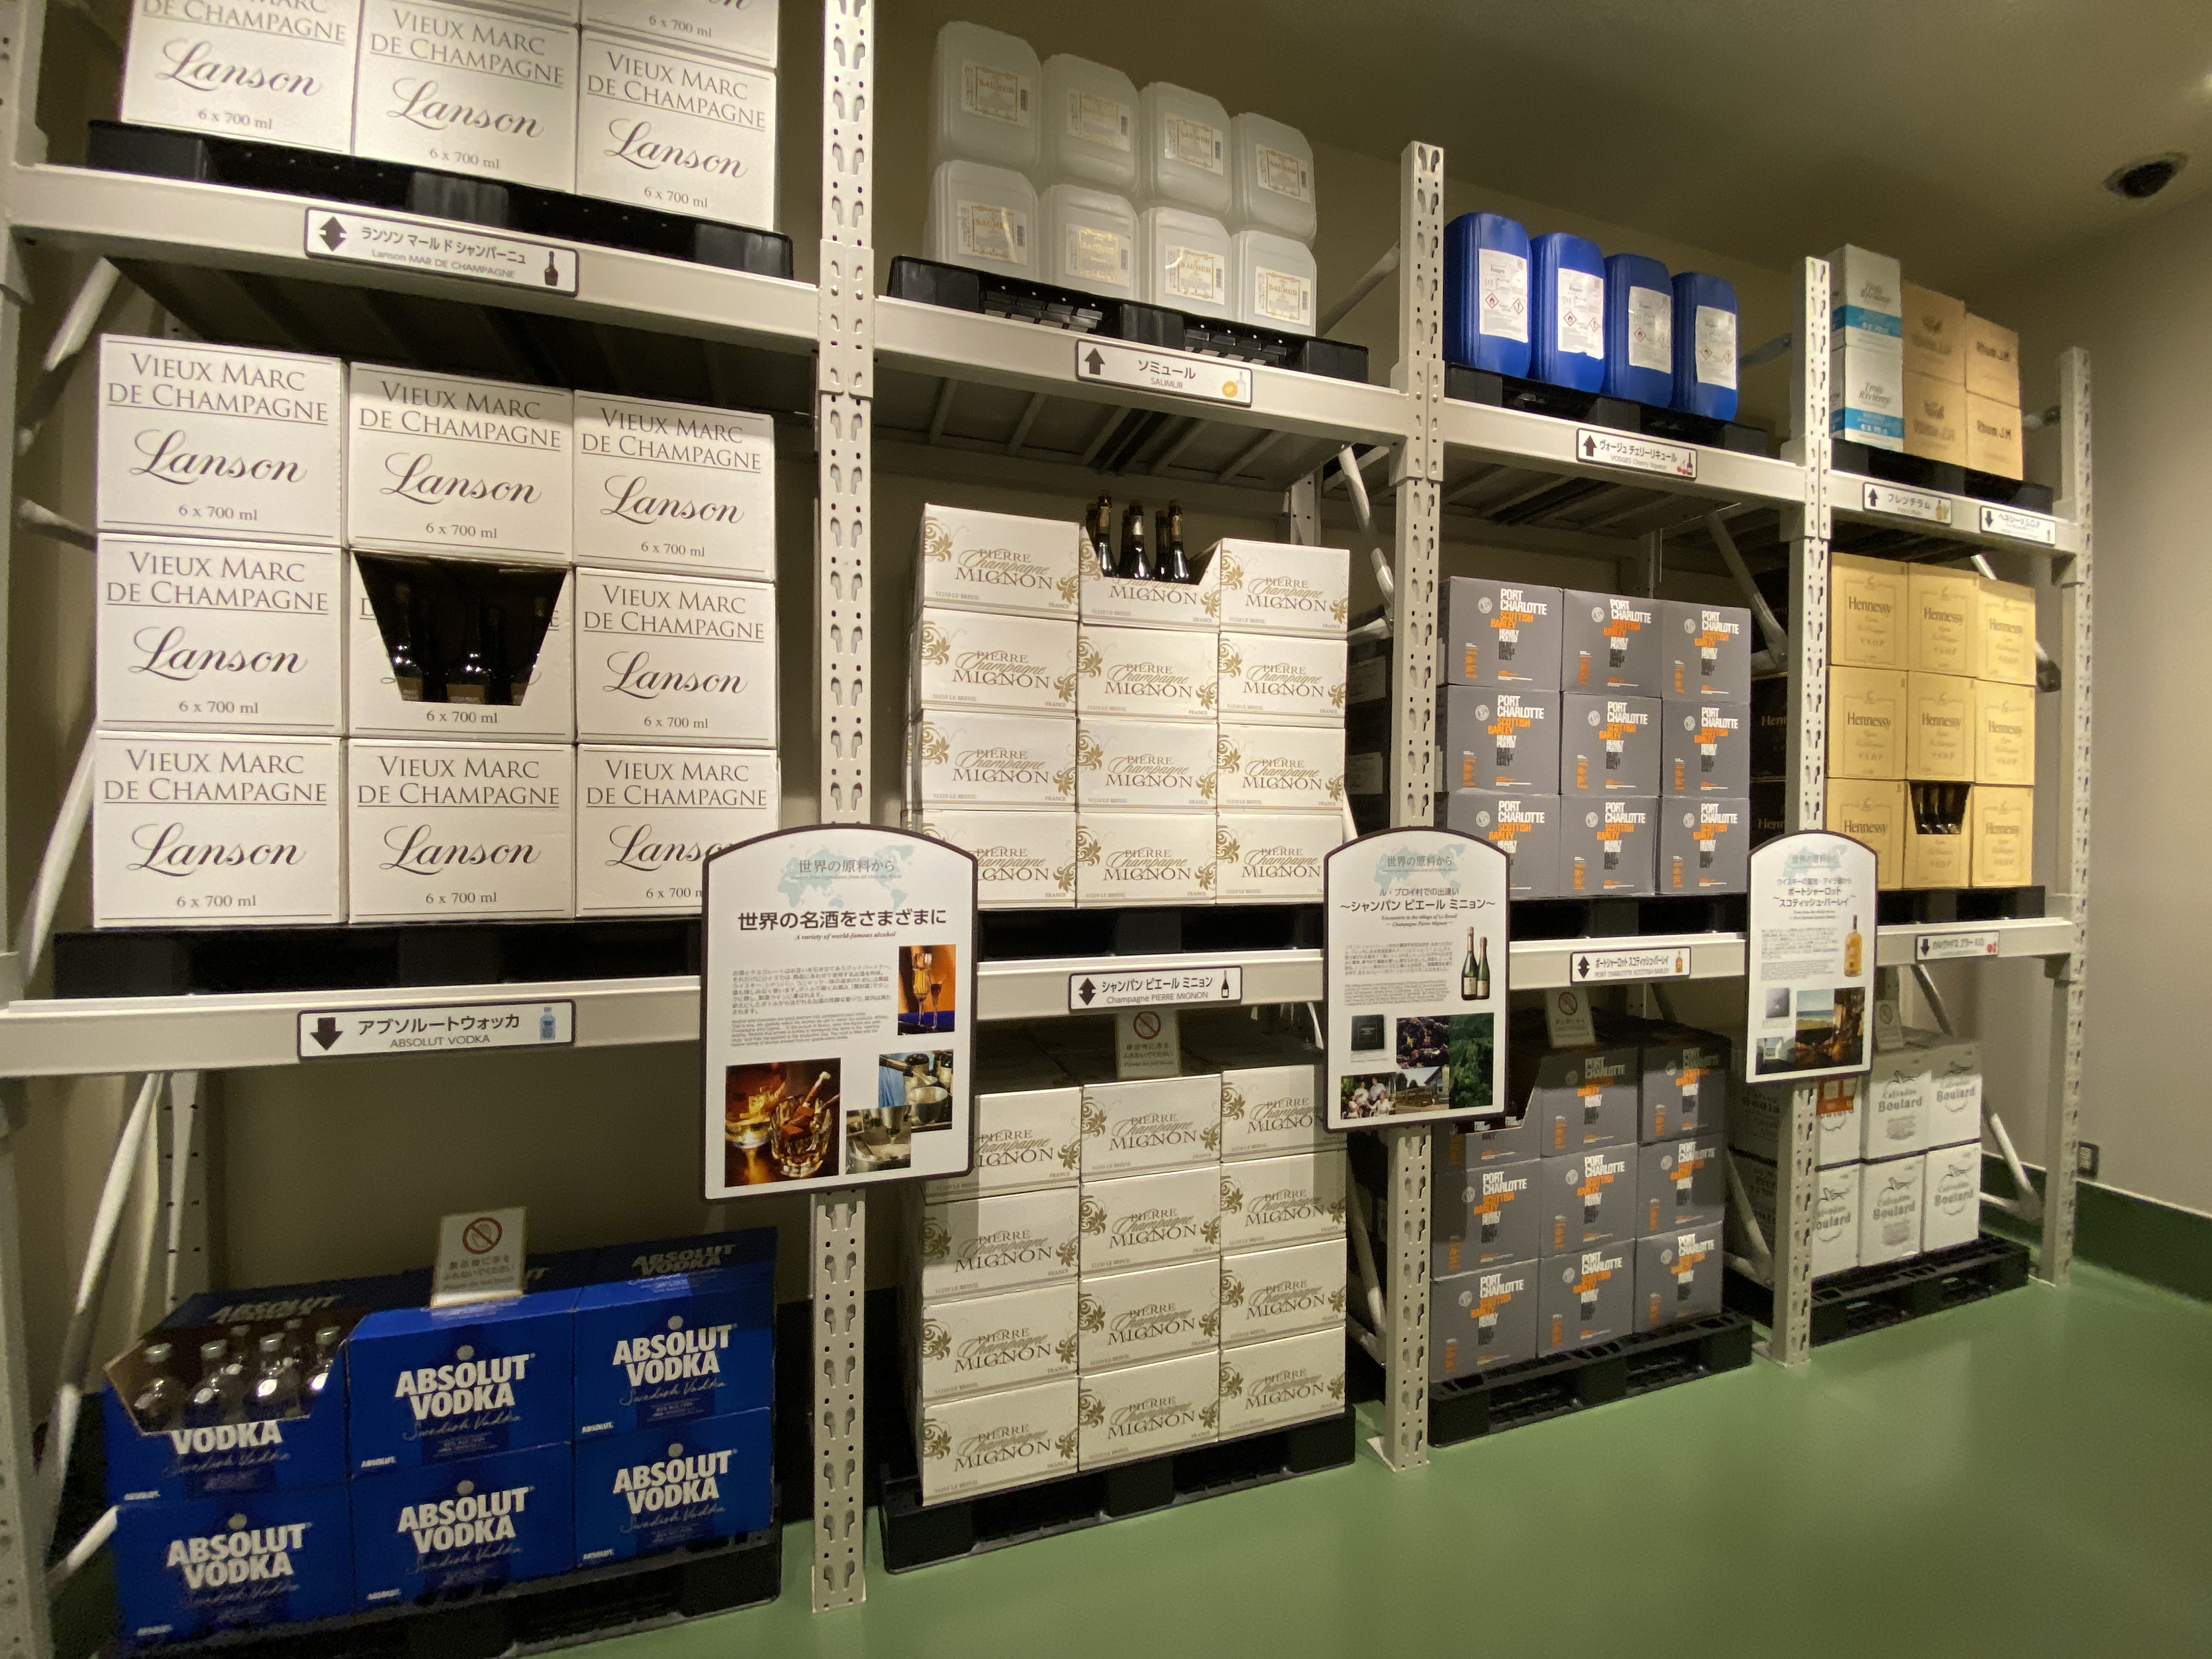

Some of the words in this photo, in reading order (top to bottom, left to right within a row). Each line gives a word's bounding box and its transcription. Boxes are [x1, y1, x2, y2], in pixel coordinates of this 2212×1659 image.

[393, 9, 464, 40] VIEUX
[473, 24, 545, 56] MARC
[370, 33, 401, 54] DE
[410, 38, 564, 84] CHAMPAGNE
[607, 52, 674, 84] VIEUX
[681, 67, 748, 100] MARC
[386, 77, 544, 138] Lanson
[588, 75, 616, 95] DE
[624, 81, 765, 128] CHAMPAGNE
[603, 119, 748, 178] Lanson
[644, 187, 652, 197] 6
[656, 191, 662, 200] x
[667, 191, 689, 204] 700
[693, 198, 708, 208] ml
[362, 227, 403, 244] ランソン
[408, 234, 438, 251] マール
[456, 243, 526, 264] シャンパーニュ
[372, 250, 406, 262] Lanson
[409, 255, 431, 266] MAR
[435, 259, 448, 268] DE
[450, 260, 514, 278] CHAMPAGNE
[1268, 284, 1298, 297] SAUMUR
[132, 353, 213, 382] VIEUX
[221, 362, 305, 391] MARC
[1138, 360, 1195, 379] ソミュール
[1151, 377, 1183, 389] SAUMUR
[109, 382, 142, 404] DE
[153, 384, 328, 421] CHAMPAGNE
[382, 381, 456, 410] VIEUX
[466, 392, 541, 420] MARC
[360, 408, 392, 428] DE
[402, 410, 561, 448] CHAMPAGNE
[600, 408, 668, 435] VIEUX
[677, 418, 742, 443] MARC
[582, 433, 610, 453] DE
[619, 436, 761, 470] CHAMPAGNE
[1600, 439, 1627, 453] ヴォージュ
[129, 430, 307, 485] Lanson
[380, 453, 542, 505] Lanson
[600, 475, 744, 524] Lanson
[179, 505, 188, 516] 6
[193, 509, 202, 517] x
[207, 506, 234, 518] 700
[239, 509, 257, 521] ml
[129, 551, 212, 577] VIEUX
[222, 557, 305, 582] MARC
[958, 549, 1051, 575] Champagne
[980, 549, 1031, 563] PIERRE
[955, 567, 1052, 589] MIGNON
[108, 582, 140, 602] DE
[151, 581, 329, 611] CHAMPAGNE
[1110, 586, 1198, 605] MIGNON
[1245, 595, 1327, 611] MIGNON
[1500, 588, 1523, 601] PORT
[1500, 600, 1547, 615] CHARLOTTE
[1702, 611, 1721, 622] PORT
[1849, 596, 1891, 617] Hennessy
[1702, 620, 1739, 634] CHARLOTTE
[128, 627, 308, 681] Lanson
[1108, 663, 1189, 684] Champagne
[1127, 664, 1173, 674] PIERRE
[1105, 682, 1192, 697] MIGNON
[1497, 695, 1521, 707] PORT
[1497, 706, 1544, 719] CHARLOTTE
[1848, 712, 1892, 730] Hennessy
[377, 755, 455, 777] VIEUX
[465, 758, 539, 778] MARC
[357, 785, 390, 804] DE
[400, 782, 560, 804] CHAMPAGNE
[1605, 802, 1625, 812] PORT
[1605, 811, 1646, 823] CHARLOTTE
[380, 824, 541, 875] Lanson
[799, 860, 894, 873] 世界の原料から
[1387, 856, 1452, 867] 世界の原料から
[426, 893, 434, 904] 6
[452, 893, 475, 903] 700
[481, 892, 496, 902] ml
[1406, 899, 1445, 911] ピエール
[738, 908, 946, 931] 世界の名酒をさまざまに
[832, 932, 872, 940] world-famous
[1103, 978, 1142, 994] シャンパン
[1146, 977, 1180, 990] ピエール
[1183, 977, 1212, 989] ミニョン
[1107, 995, 1149, 1005] Champagne
[1152, 993, 1174, 1001] PIERRE
[1176, 992, 1208, 1000] MIGNON
[358, 1014, 519, 1035] アブソルートウォッカ
[390, 1036, 444, 1048] ABSOLUT
[447, 1035, 490, 1046] VODKA
[1878, 1097, 1922, 1113] Boulard
[1131, 1113, 1176, 1125] PIERRE
[1109, 1130, 1198, 1151] MIGNON
[1245, 1205, 1325, 1227] MIGNON
[1873, 1200, 1915, 1220] Boulard
[613, 1324, 732, 1365] ABSOLUT
[626, 1351, 720, 1386] VODKA
[954, 1344, 1051, 1373] MIGNON
[395, 1354, 530, 1397] ABSOLUT
[410, 1383, 516, 1420] VODKA
[1108, 1411, 1194, 1440] MIGNON
[171, 1420, 283, 1454] VODKA
[613, 1450, 732, 1494] ABSOLUT
[627, 1476, 719, 1514] VODKA
[398, 1487, 529, 1533] ABSOLUT
[167, 1523, 306, 1567] ABSOLUT
[413, 1515, 516, 1554] VODKA
[182, 1551, 294, 1589] VODKA
